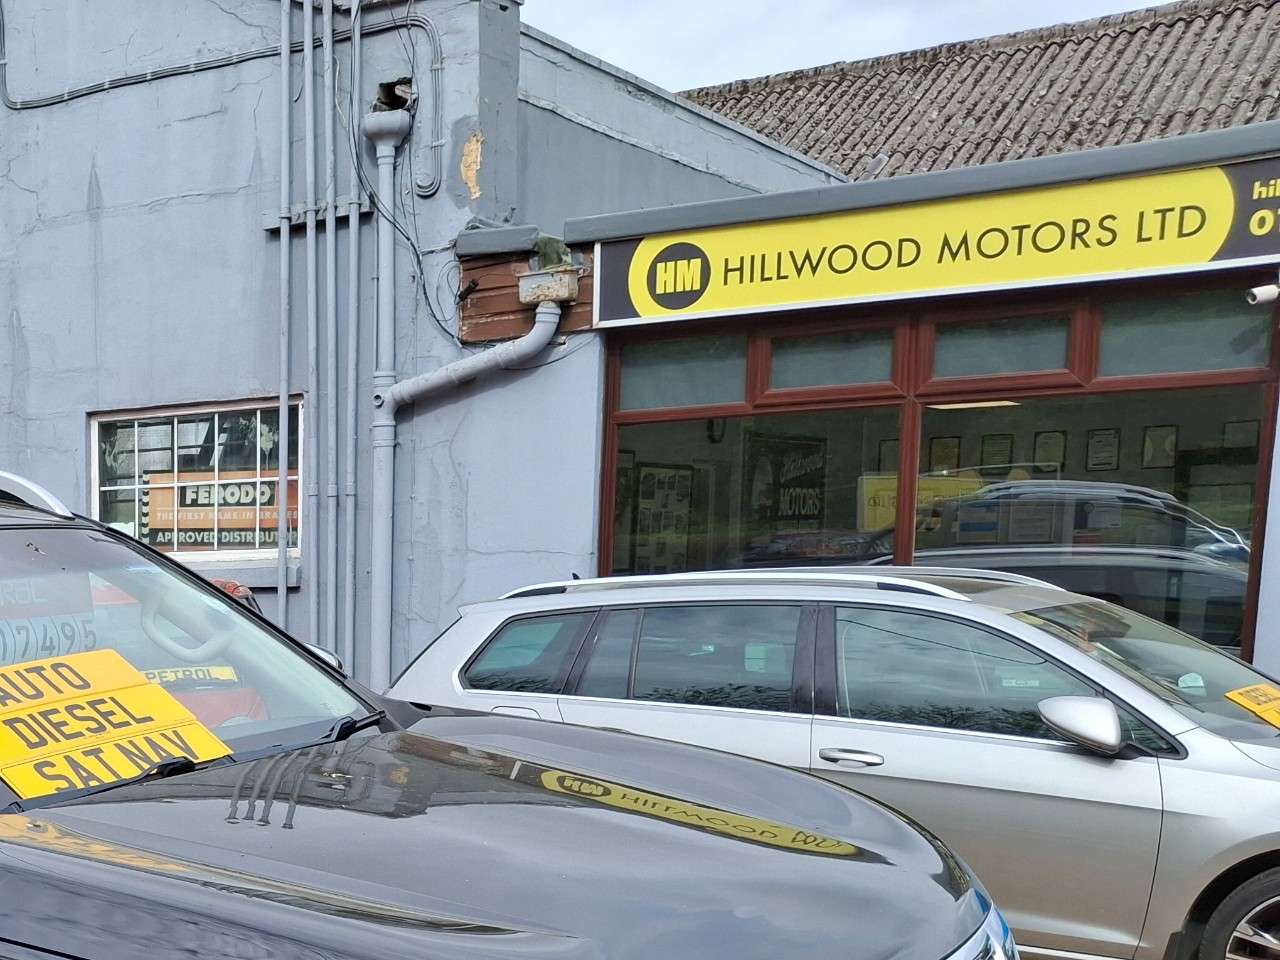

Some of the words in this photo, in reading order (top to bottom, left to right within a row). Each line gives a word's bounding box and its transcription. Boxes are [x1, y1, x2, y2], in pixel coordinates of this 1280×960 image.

[722, 236, 922, 287] HILLWOOD
[936, 212, 1119, 266] MOTORS
[1135, 204, 1207, 244] LTD
[655, 258, 702, 296] HM
[185, 484, 271, 504] FERODO
[2, 696, 155, 750] DIESEL
[32, 746, 121, 792] SAT
[115, 729, 199, 773] NAV
